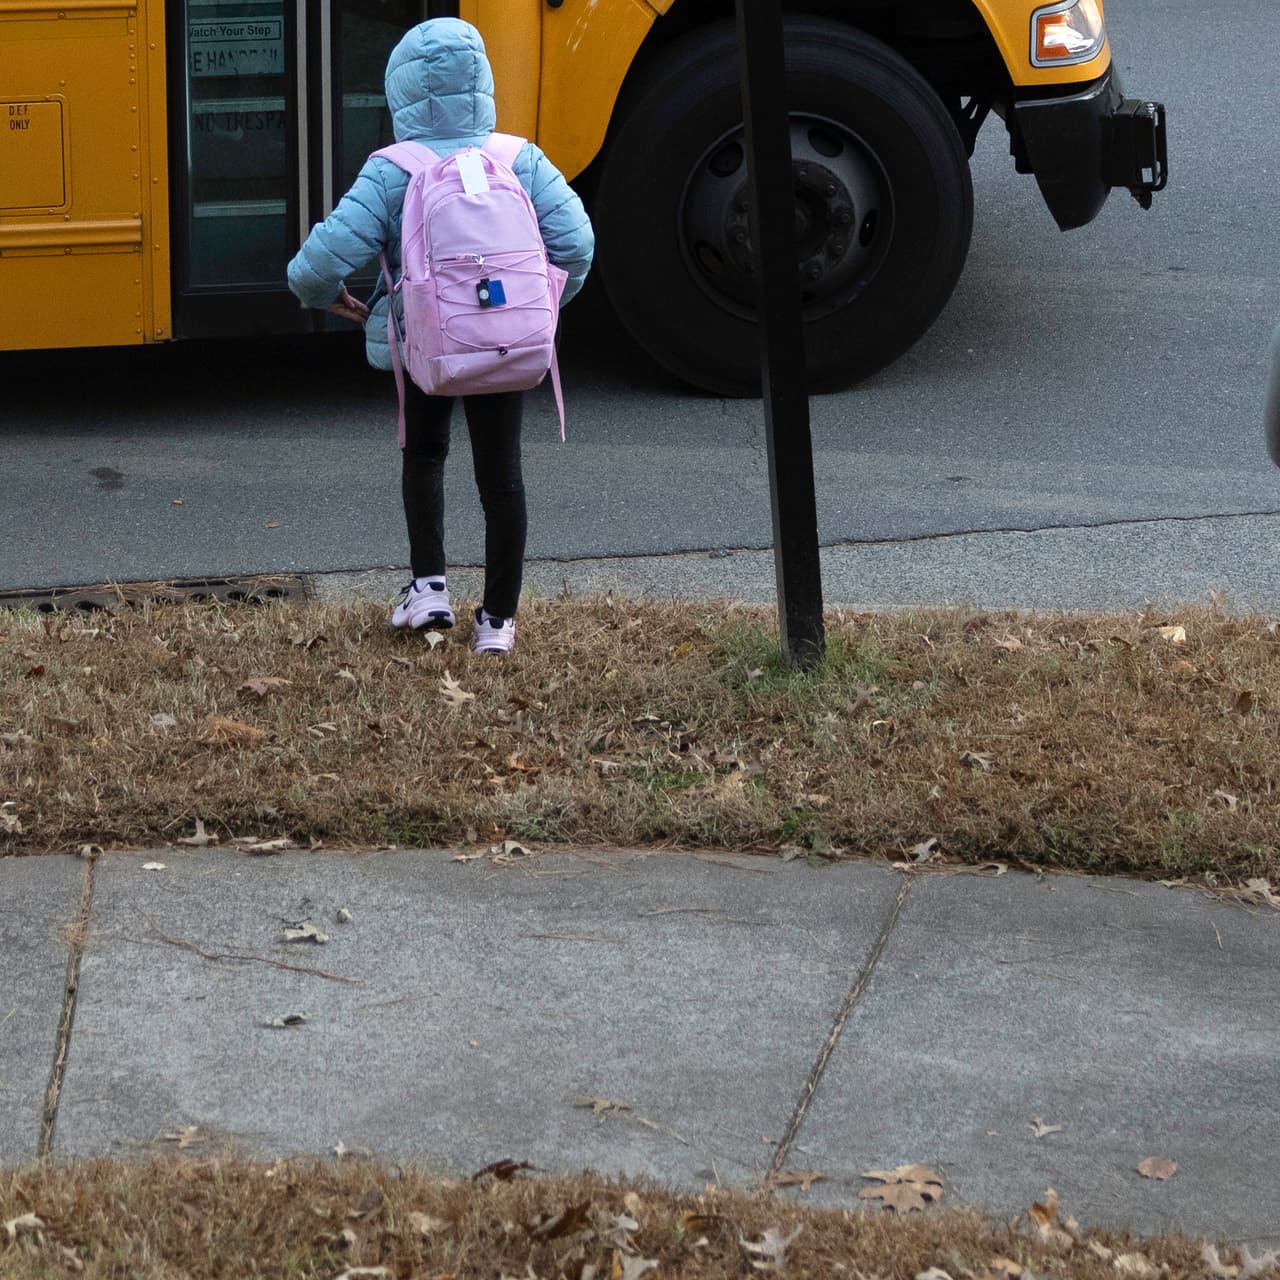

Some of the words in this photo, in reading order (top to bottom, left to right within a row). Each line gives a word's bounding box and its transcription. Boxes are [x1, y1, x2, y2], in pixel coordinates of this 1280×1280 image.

[220, 26, 244, 36] Your
[247, 24, 272, 37] Step
[10, 118, 31, 130] ONLY
